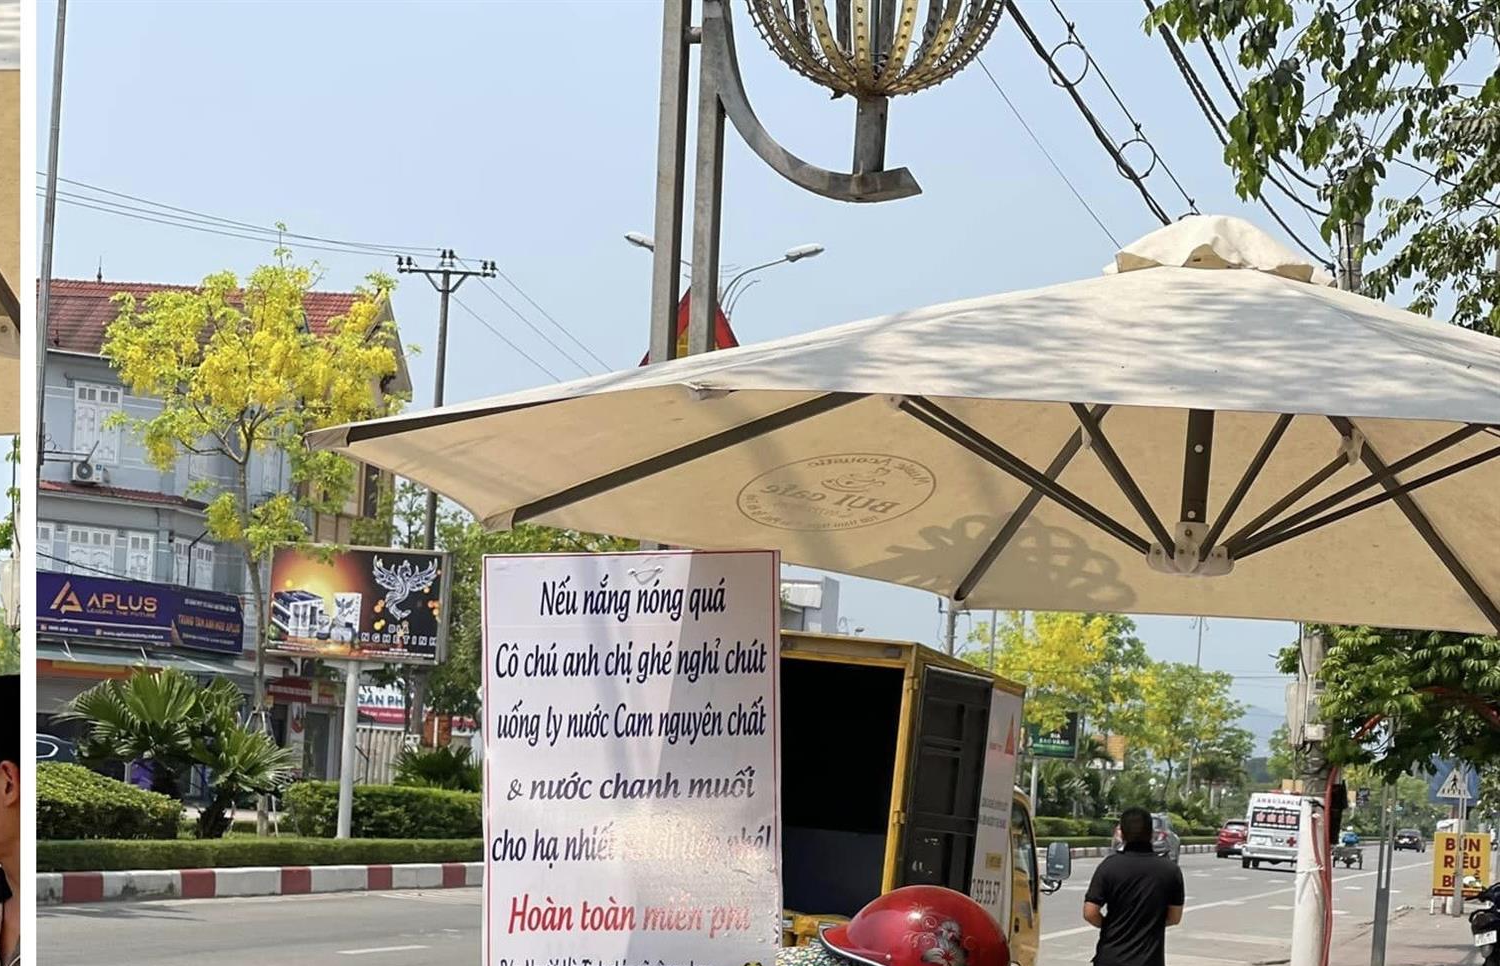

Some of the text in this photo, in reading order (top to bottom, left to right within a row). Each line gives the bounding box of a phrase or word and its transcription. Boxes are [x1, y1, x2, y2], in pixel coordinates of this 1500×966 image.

[87, 592, 158, 612] APLUS
[540, 574, 726, 622] Nếu nắng nóng quá
[495, 637, 767, 684] Cô chú anh chị ghé nghỉ chút
[498, 696, 767, 747] uống ly nước Cam nguyên chất
[507, 765, 756, 801] & nước chanh muối
[491, 829, 526, 862] cho
[532, 829, 558, 868] hạ
[507, 894, 573, 935] Hoàn
[580, 896, 636, 932] toàn
